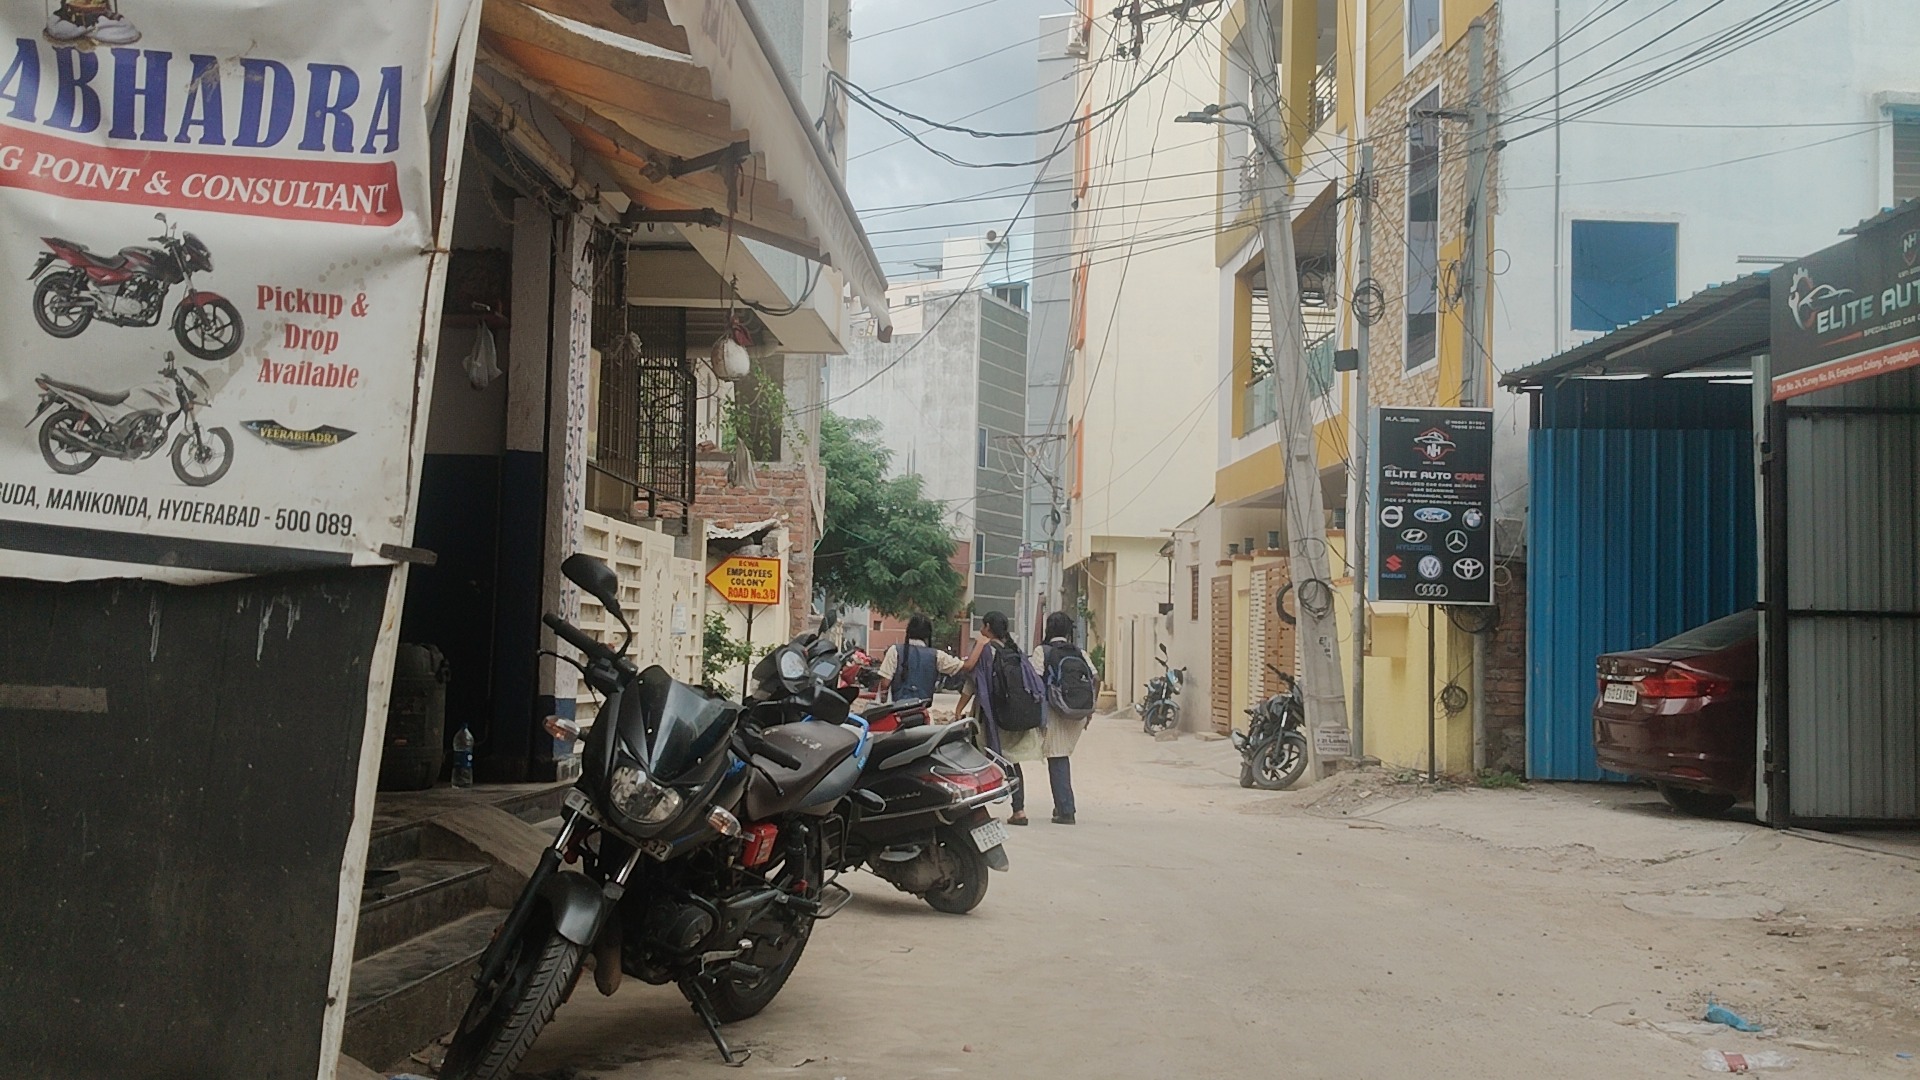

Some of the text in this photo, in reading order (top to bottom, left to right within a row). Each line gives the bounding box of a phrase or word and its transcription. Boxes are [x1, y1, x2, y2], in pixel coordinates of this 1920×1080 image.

[29, 151, 140, 191] POINT
[144, 170, 171, 196] &
[181, 173, 389, 214] CONSULTANT
[257, 285, 370, 318] Pickup &
[1817, 294, 1874, 334] ELITE
[283, 322, 339, 355] Drop
[257, 358, 360, 389] Available
[260, 427, 339, 444] VEERABHADRA
[1384, 470, 1486, 481] ELITE AUTO CARE
[0, 481, 40, 510] UDA,
[45, 487, 152, 522] MANIKONDA,
[157, 498, 260, 528] HYDERABAD
[274, 508, 311, 533] 500
[315, 511, 357, 538] 089.
[726, 567, 773, 579] EMPLOYEES
[730, 577, 766, 587] COLONY
[728, 586, 749, 599] ROAD
